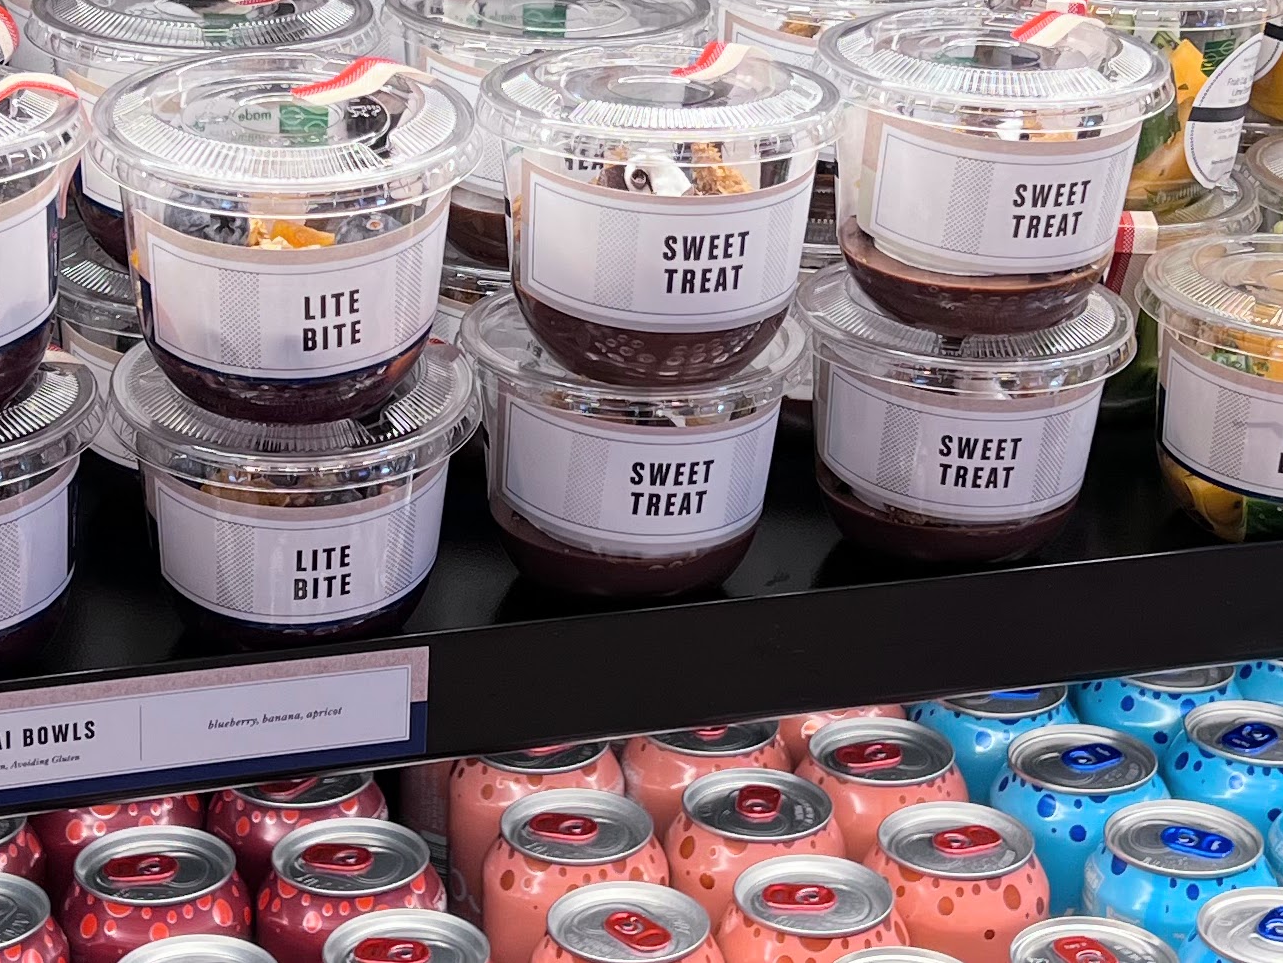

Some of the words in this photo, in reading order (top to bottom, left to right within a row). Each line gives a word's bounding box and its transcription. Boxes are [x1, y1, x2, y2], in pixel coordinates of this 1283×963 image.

[1012, 179, 1091, 209] SWEET
[1012, 211, 1083, 239] TREAT
[662, 231, 750, 261] SWEET
[664, 264, 744, 294] TREAT
[304, 289, 360, 321] LITE
[302, 320, 361, 352] BITE
[938, 434, 1022, 461] SWEET
[629, 459, 715, 486] SWEET
[938, 464, 1015, 489] TREAT
[630, 490, 707, 516] TREAT
[296, 545, 351, 572] LITE
[293, 573, 351, 600] BITE
[207, 715, 259, 731] blueberry,
[262, 710, 303, 724] banana,
[306, 705, 343, 721] apricot
[23, 720, 96, 747] BOWLS
[10, 757, 49, 769] Avoiding
[51, 753, 81, 764] Gluten
